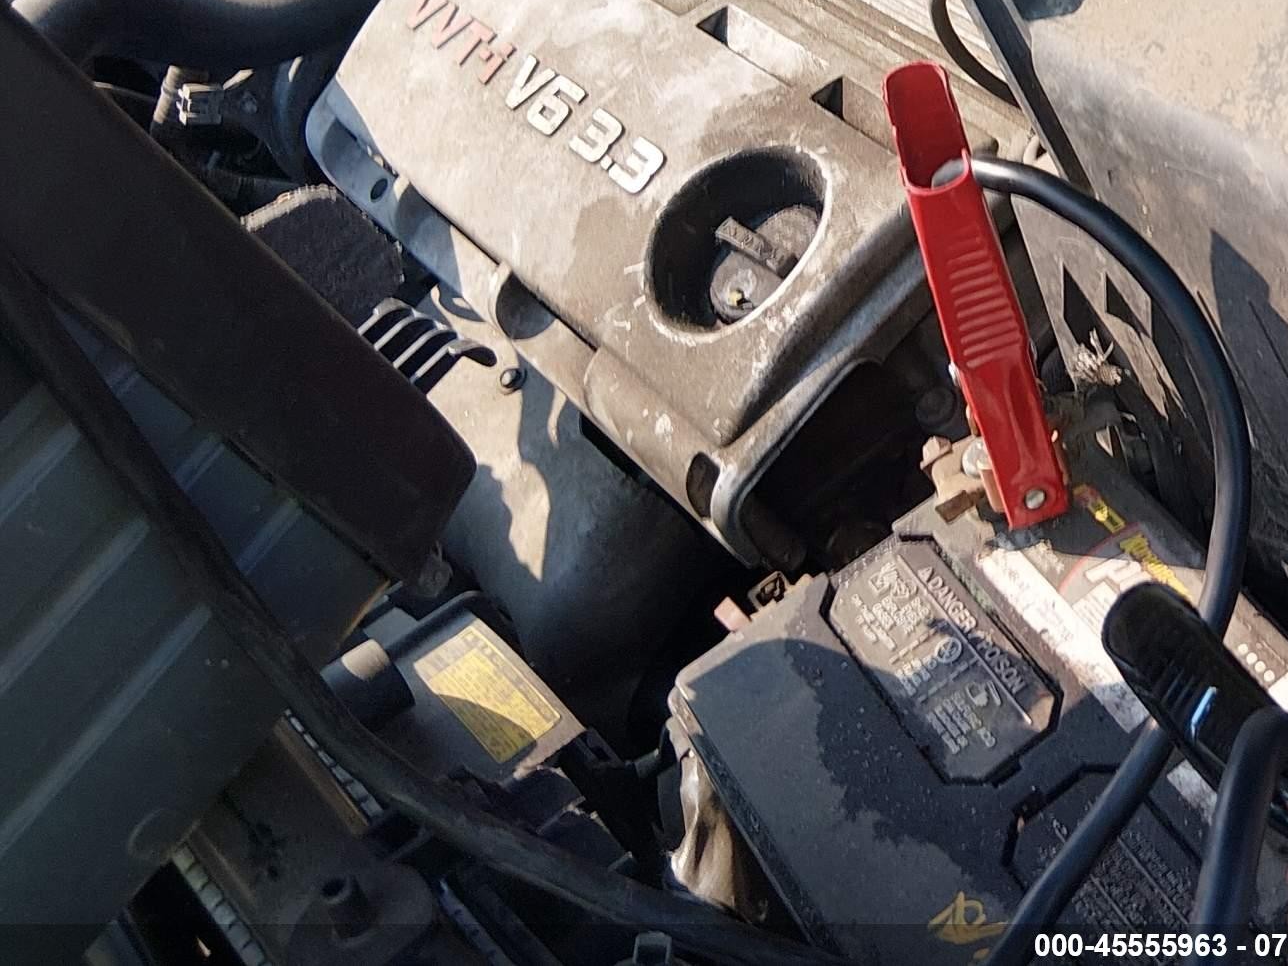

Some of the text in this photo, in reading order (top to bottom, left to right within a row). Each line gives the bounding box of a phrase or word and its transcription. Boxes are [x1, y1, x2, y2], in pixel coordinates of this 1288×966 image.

[505, 53, 589, 137] V6
[568, 107, 667, 194] 3.3
[924, 574, 978, 634] DANGER
[974, 636, 1028, 694] POISON
